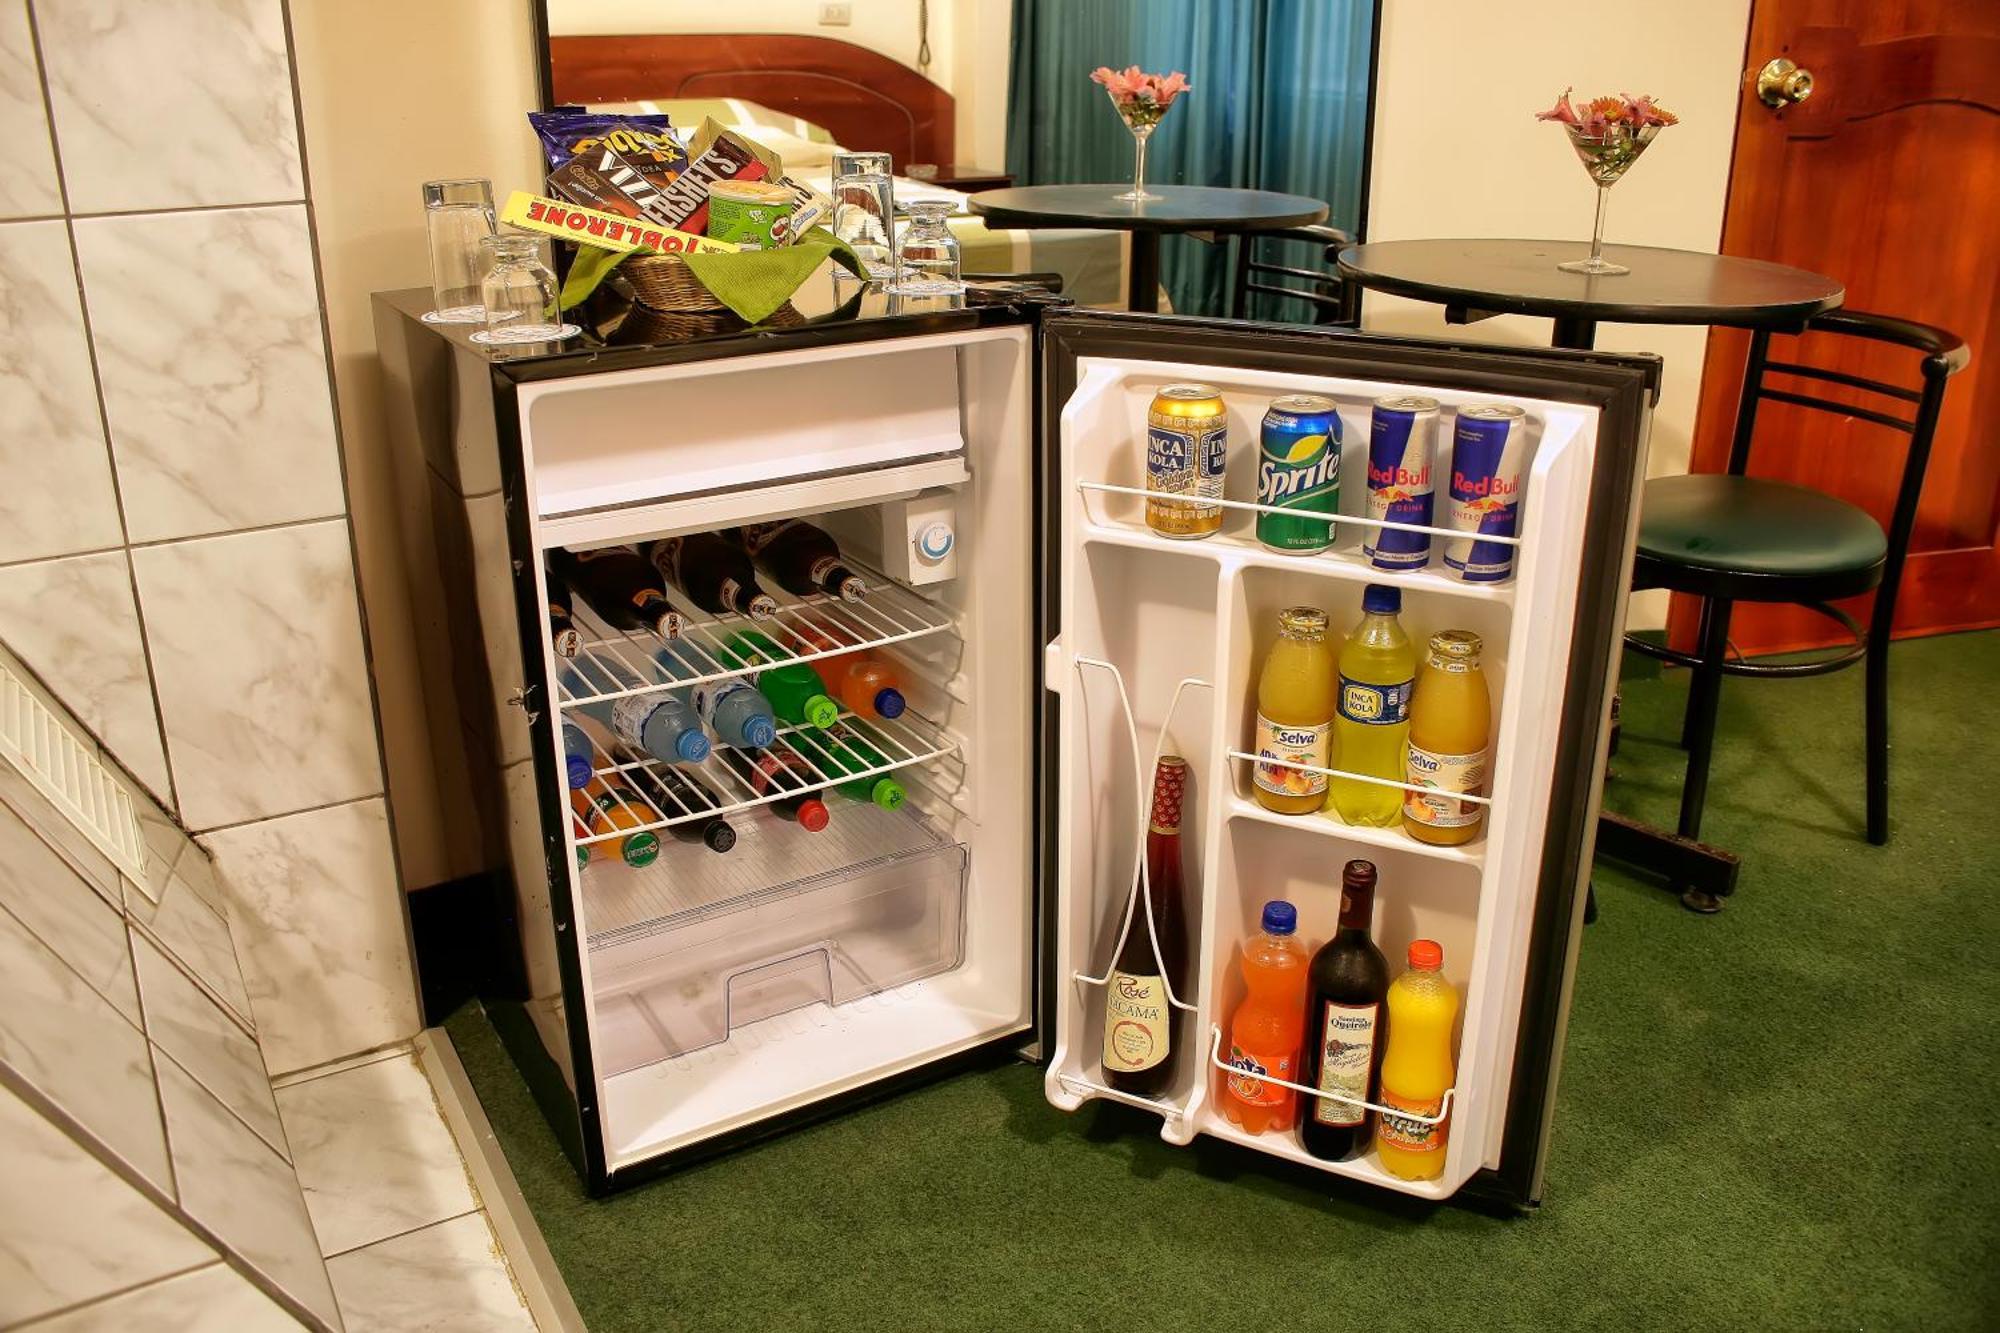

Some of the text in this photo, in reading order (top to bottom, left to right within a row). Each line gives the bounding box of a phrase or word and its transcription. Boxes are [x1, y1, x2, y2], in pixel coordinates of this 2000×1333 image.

[526, 201, 700, 253] TOBLERONE
[1150, 435, 1184, 457] NCA
[1258, 446, 1340, 505] Sprite
[1395, 465, 1429, 487] Bull
[1454, 472, 1520, 496] Red Bull
[1349, 700, 1374, 713] KOLA
[1351, 691, 1373, 704] INCA
[1279, 731, 1315, 745] Selva
[1409, 751, 1438, 770] Selva
[1116, 975, 1150, 999] Rosé
